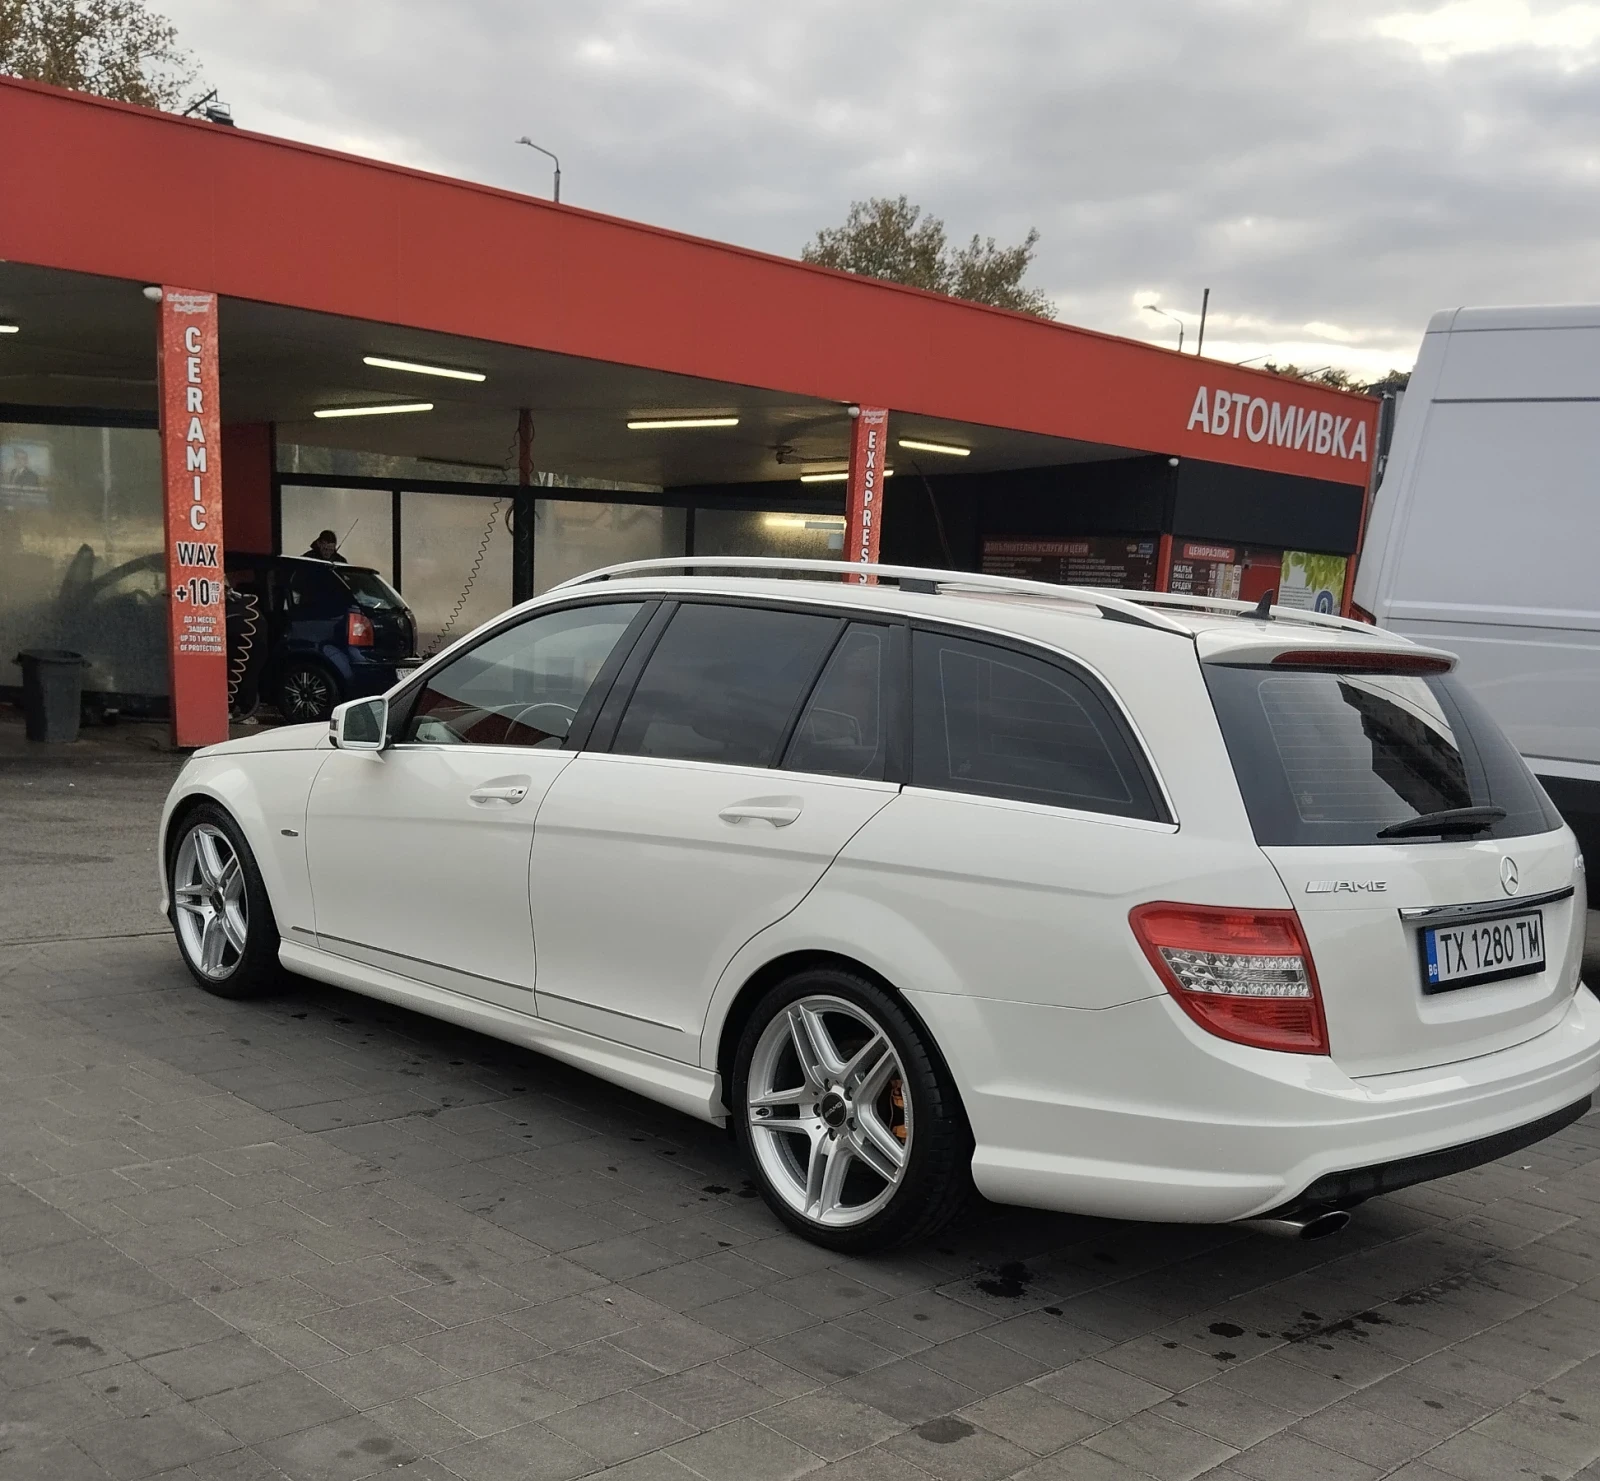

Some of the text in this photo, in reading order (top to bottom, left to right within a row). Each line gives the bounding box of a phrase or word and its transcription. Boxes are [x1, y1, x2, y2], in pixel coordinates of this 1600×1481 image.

[185, 326, 207, 531] CERAMIC
[1187, 386, 1367, 462] АВТОМИВКА
[176, 541, 219, 568] WAX
[1188, 546, 1230, 559] ЦЕНОРАЗПИС
[1173, 564, 1193, 573] МАЛЪК
[1209, 570, 1216, 579] 10
[1171, 582, 1192, 590] СРЕДЕН
[1207, 588, 1214, 597] 12
[1440, 918, 1541, 974] TX 1280 TM
[1428, 963, 1438, 976] BG
